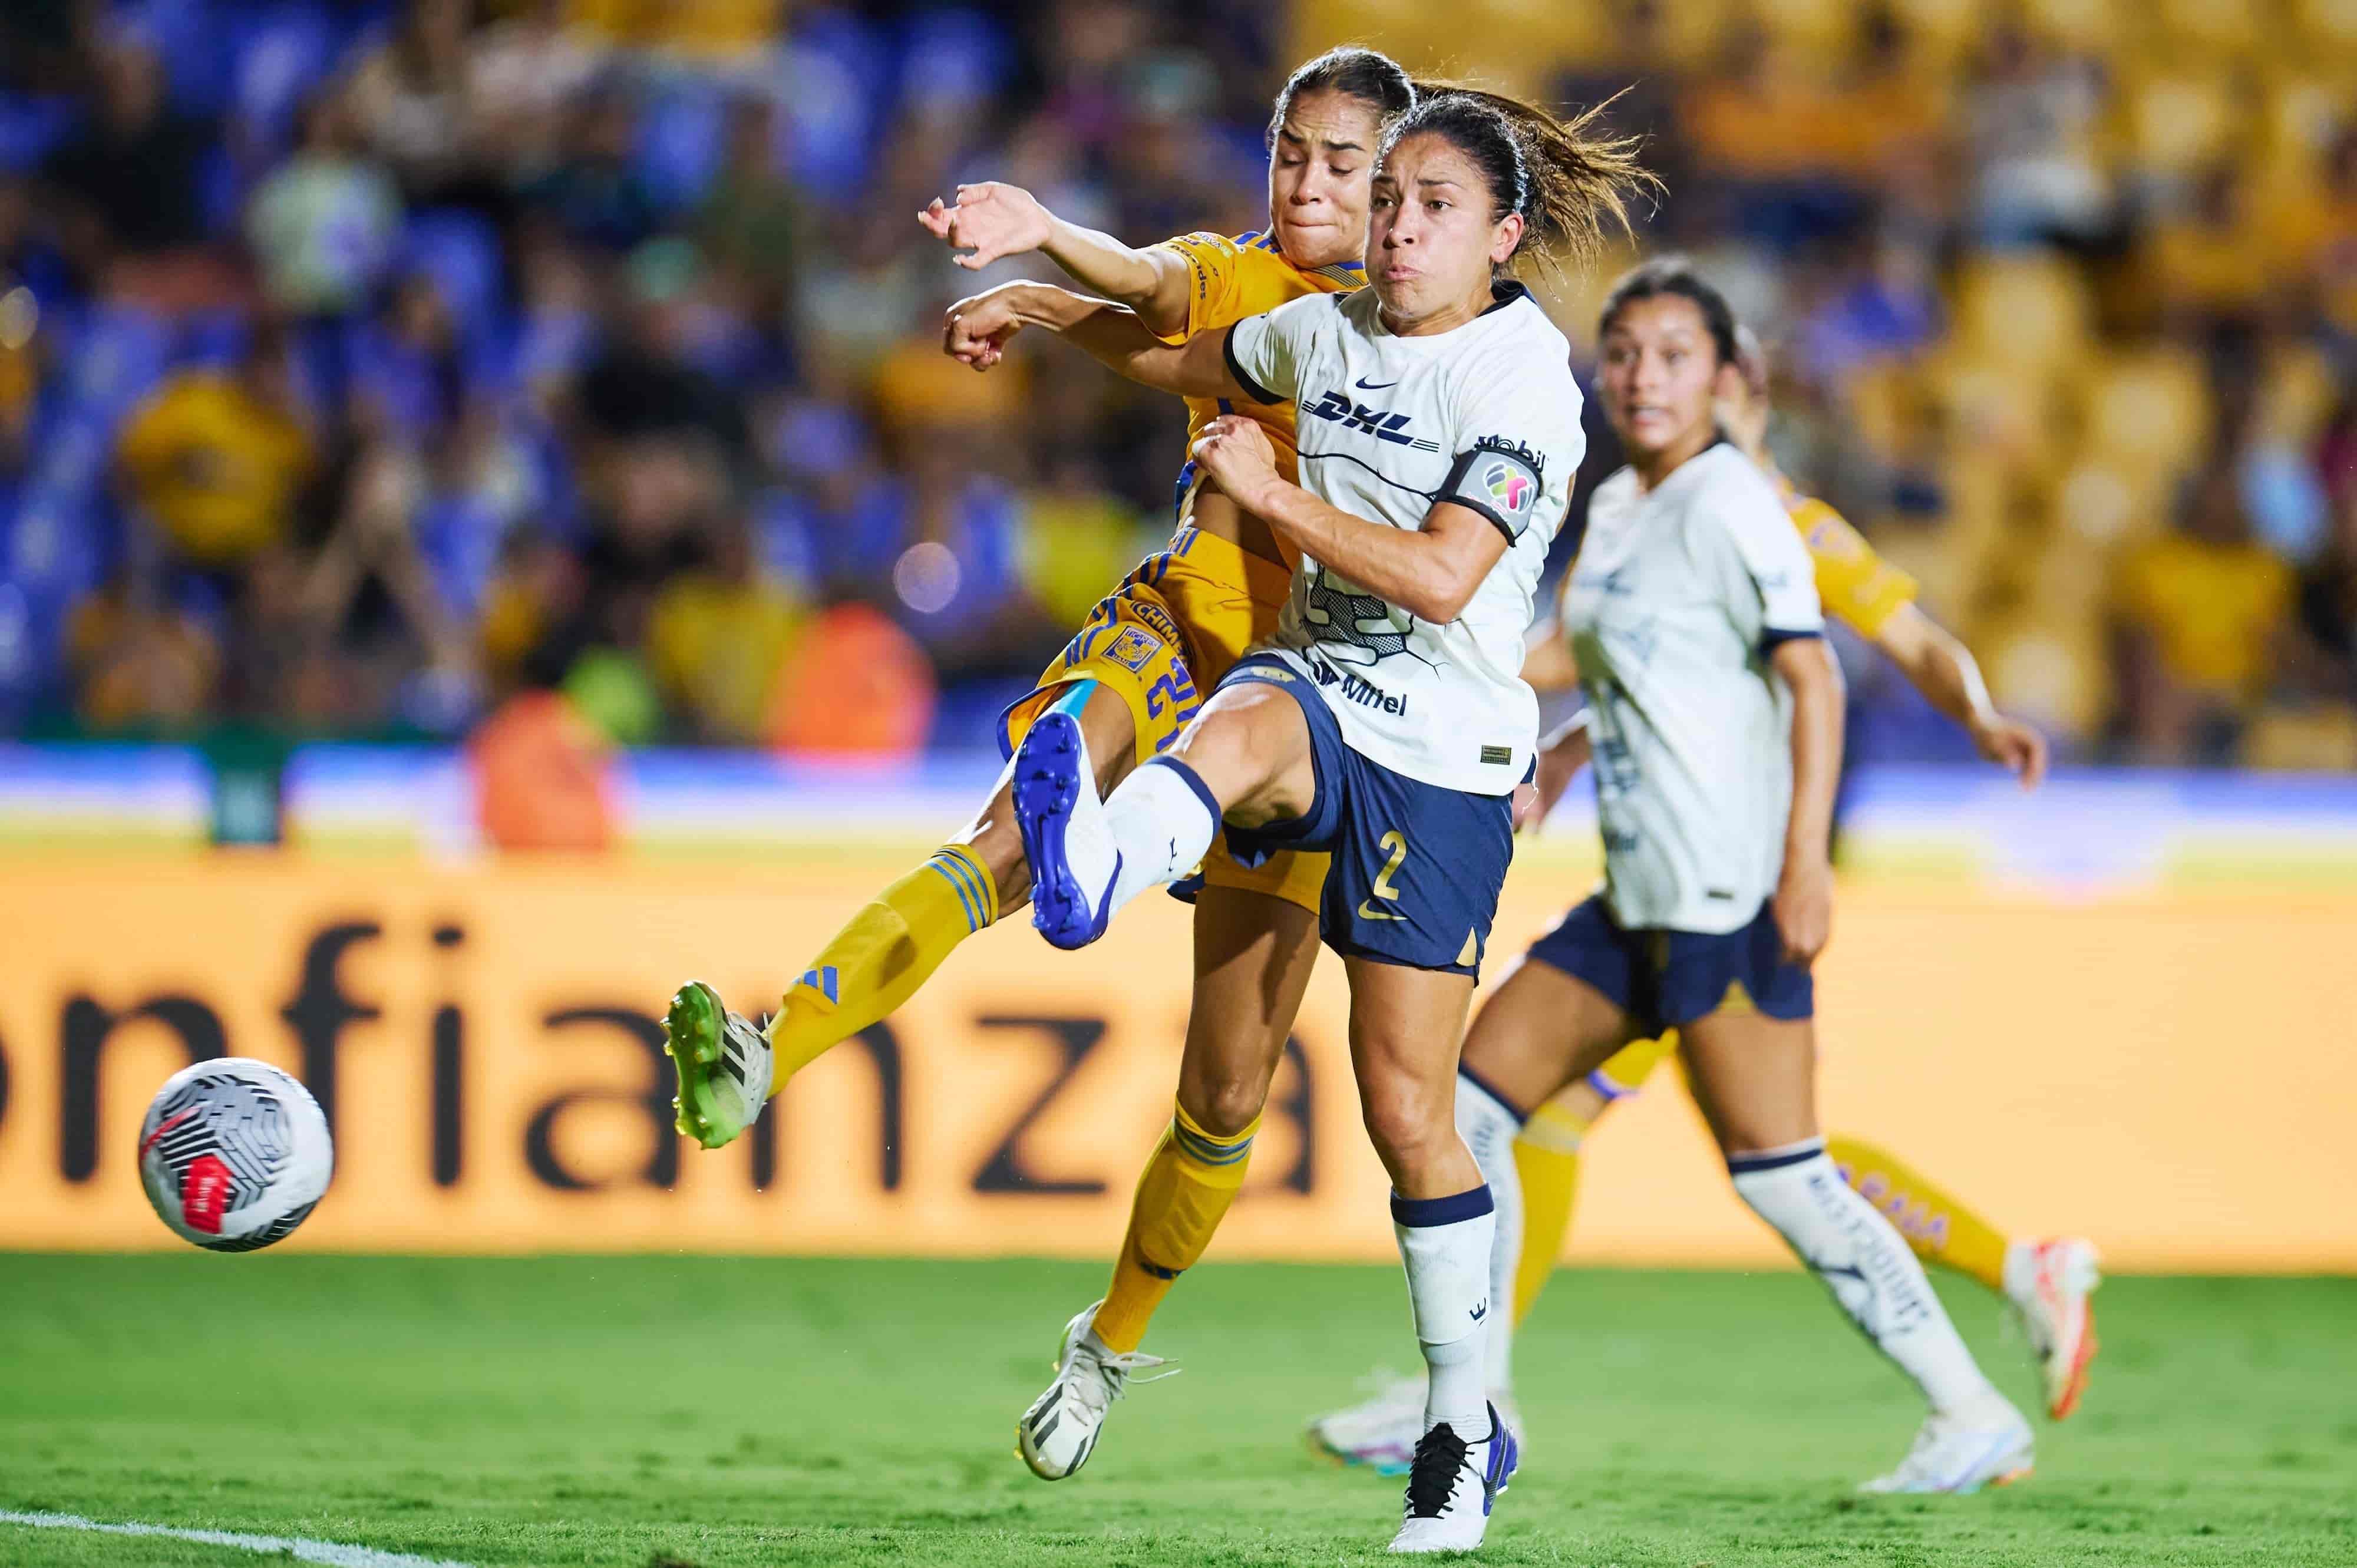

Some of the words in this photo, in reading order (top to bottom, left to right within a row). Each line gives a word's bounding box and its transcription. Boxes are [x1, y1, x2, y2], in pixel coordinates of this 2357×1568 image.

[1310, 391, 1414, 445] DHL
[1374, 830, 1407, 901] 2
[0, 920, 1311, 1196] nfianz
